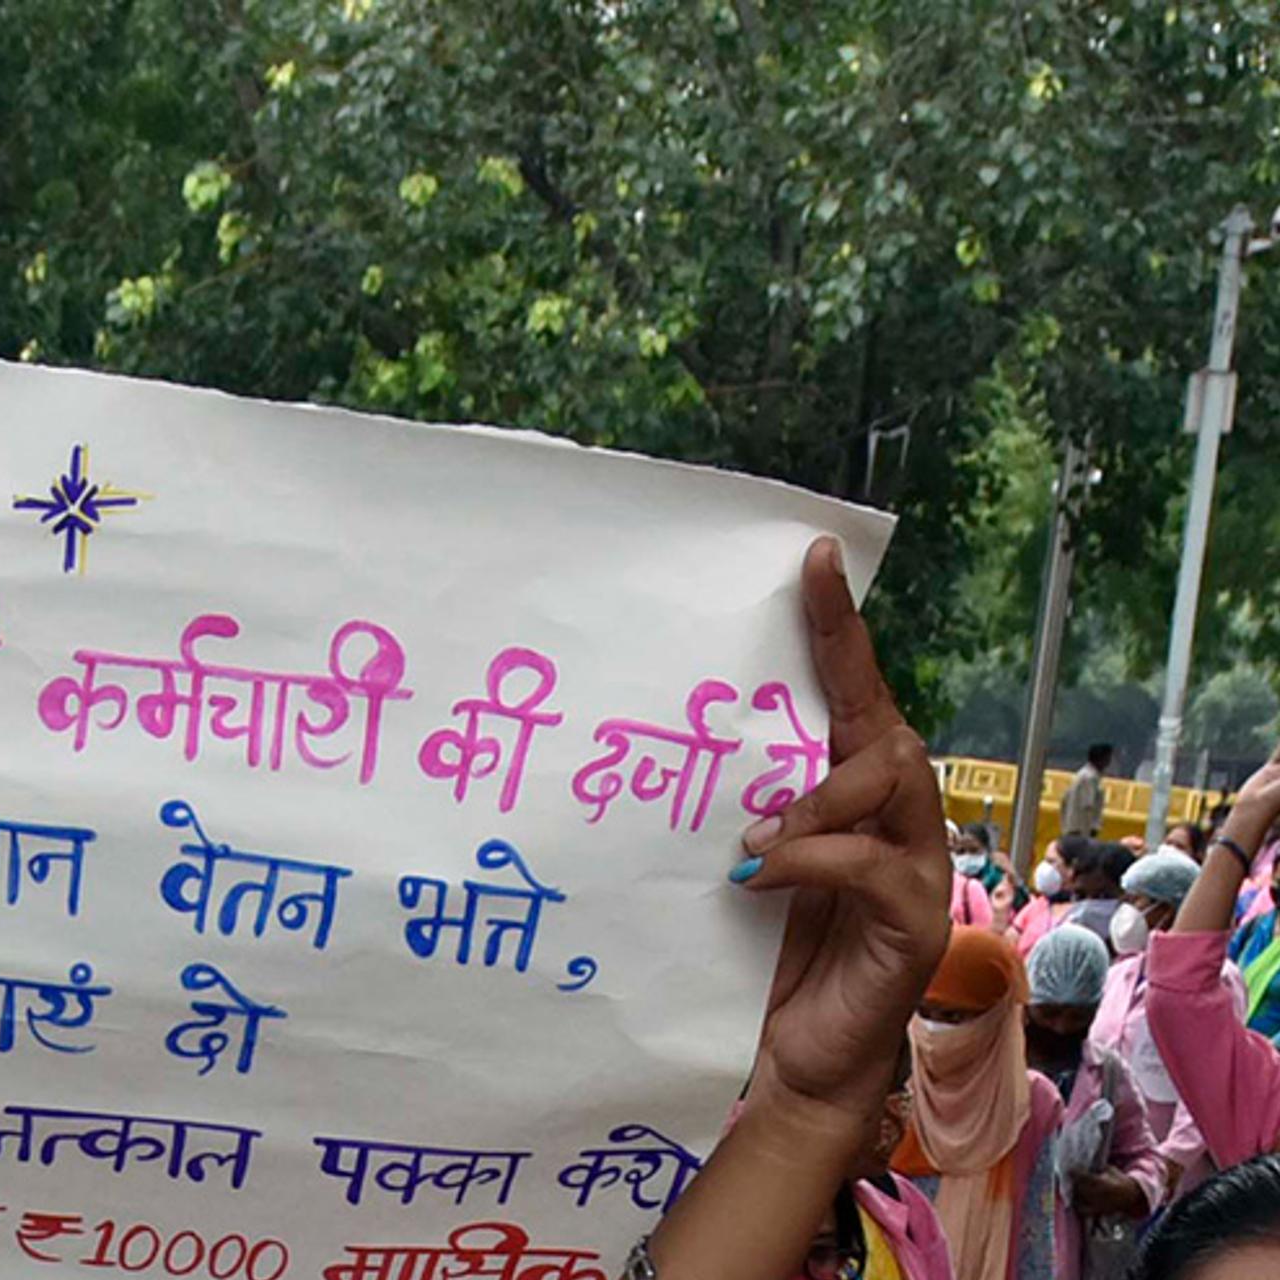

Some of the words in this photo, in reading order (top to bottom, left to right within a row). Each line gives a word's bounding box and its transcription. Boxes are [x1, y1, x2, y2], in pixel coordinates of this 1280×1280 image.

[39, 614, 414, 784] कर्मचारी
[419, 647, 563, 813] की
[572, 680, 742, 833] दर्जा
[160, 799, 353, 950] वेतन
[164, 963, 288, 1076] दो
[313, 1137, 534, 1206] पक्का
[557, 1124, 707, 1214] करो
